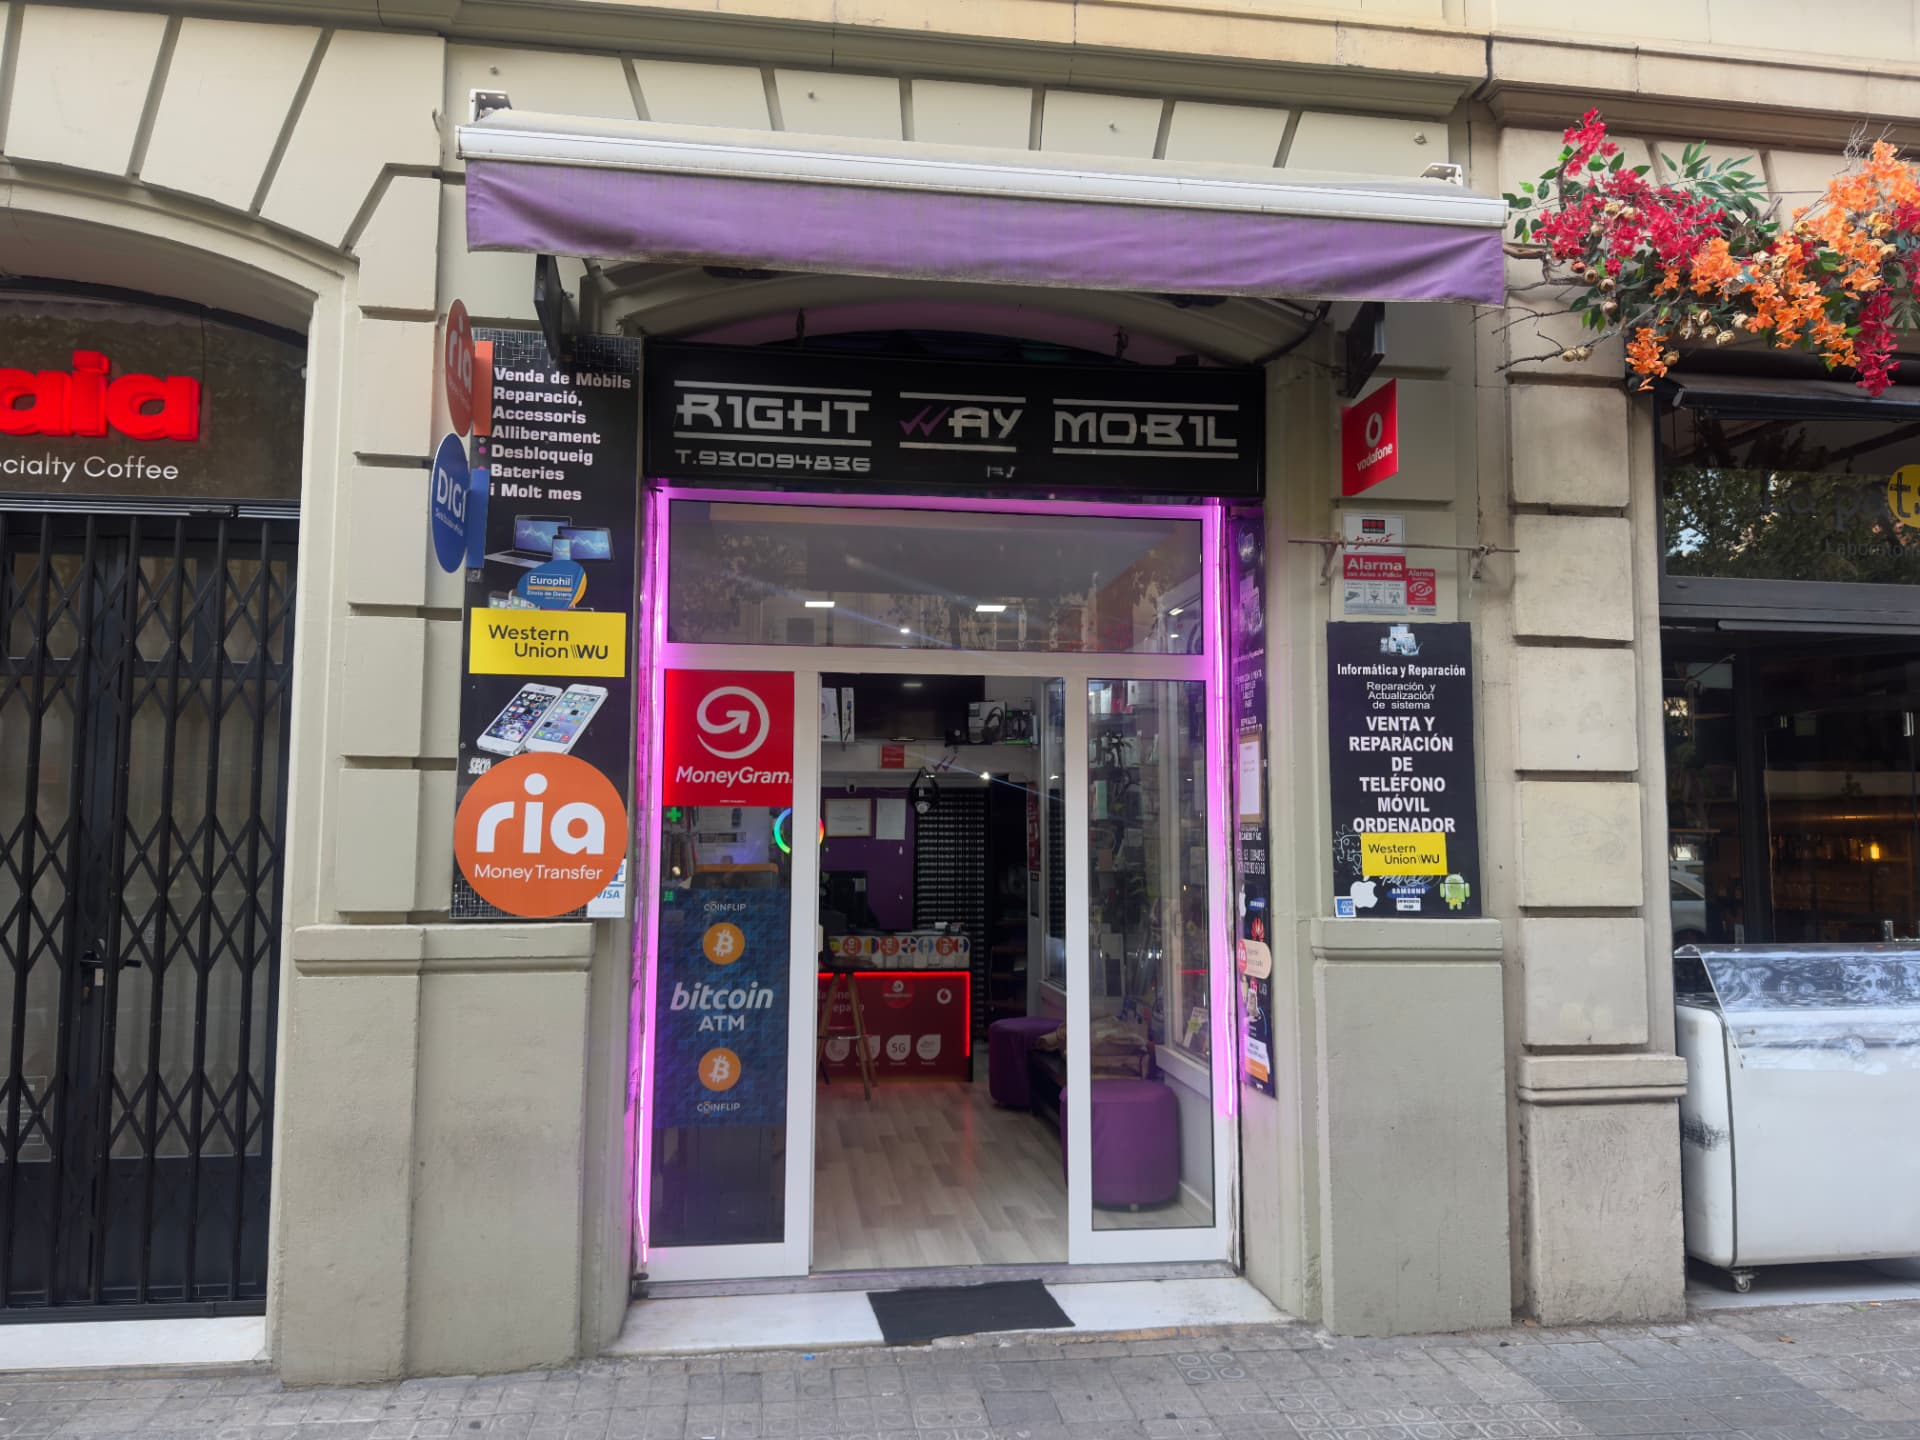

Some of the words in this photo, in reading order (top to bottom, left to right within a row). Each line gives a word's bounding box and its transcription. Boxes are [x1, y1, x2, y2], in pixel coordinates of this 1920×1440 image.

[449, 315, 472, 394] ria
[494, 367, 545, 384] Venda
[551, 370, 570, 384] de
[575, 371, 631, 389] Mòbils
[493, 387, 583, 406] Reparació,
[491, 406, 586, 424] Accessoris
[491, 425, 601, 445] Alliberament
[490, 444, 593, 466] Desbloqueig
[675, 449, 872, 472] T.930094836
[1356, 442, 1393, 472] vodafone
[84, 455, 179, 480] Coffee
[489, 464, 565, 482] Bateries
[437, 467, 466, 523] DIGI
[489, 483, 496, 497] i
[501, 483, 542, 500] Molt
[547, 486, 582, 501] mes
[1347, 557, 1402, 571] Alarma
[530, 575, 571, 587] Europhil
[488, 624, 569, 642] Western
[514, 643, 569, 659] Union
[578, 644, 609, 660] WU
[1337, 663, 1398, 676] Informática
[1400, 666, 1407, 678] y
[1408, 664, 1466, 678] Reparación
[1366, 681, 1425, 693] Reparación
[1429, 683, 1436, 693] y
[1368, 690, 1435, 701] Actualización
[1372, 700, 1386, 710] de
[1391, 700, 1431, 710] sistema
[1366, 716, 1421, 732] VENTA
[1424, 716, 1435, 732] Y
[1349, 733, 1453, 752] REPARACIÓN
[1391, 756, 1413, 772] DE
[675, 766, 790, 789] MoneyGram
[1359, 774, 1446, 793] TELÉFONO
[1377, 793, 1430, 813] MÓVIL
[476, 772, 606, 856] ria
[1353, 817, 1456, 833] ORDENADOR
[1367, 843, 1416, 853] Western
[1384, 854, 1417, 865] Union
[1420, 854, 1440, 865] WU
[474, 864, 532, 882] Money
[536, 864, 604, 881] Transfer
[1391, 887, 1426, 896] SAMSUNG
[703, 902, 747, 913] COINFLIP
[670, 981, 774, 1011] bitcoin
[698, 1014, 746, 1032] ATM
[891, 1043, 906, 1054] 5G
[697, 1102, 741, 1114] COINFLIP
